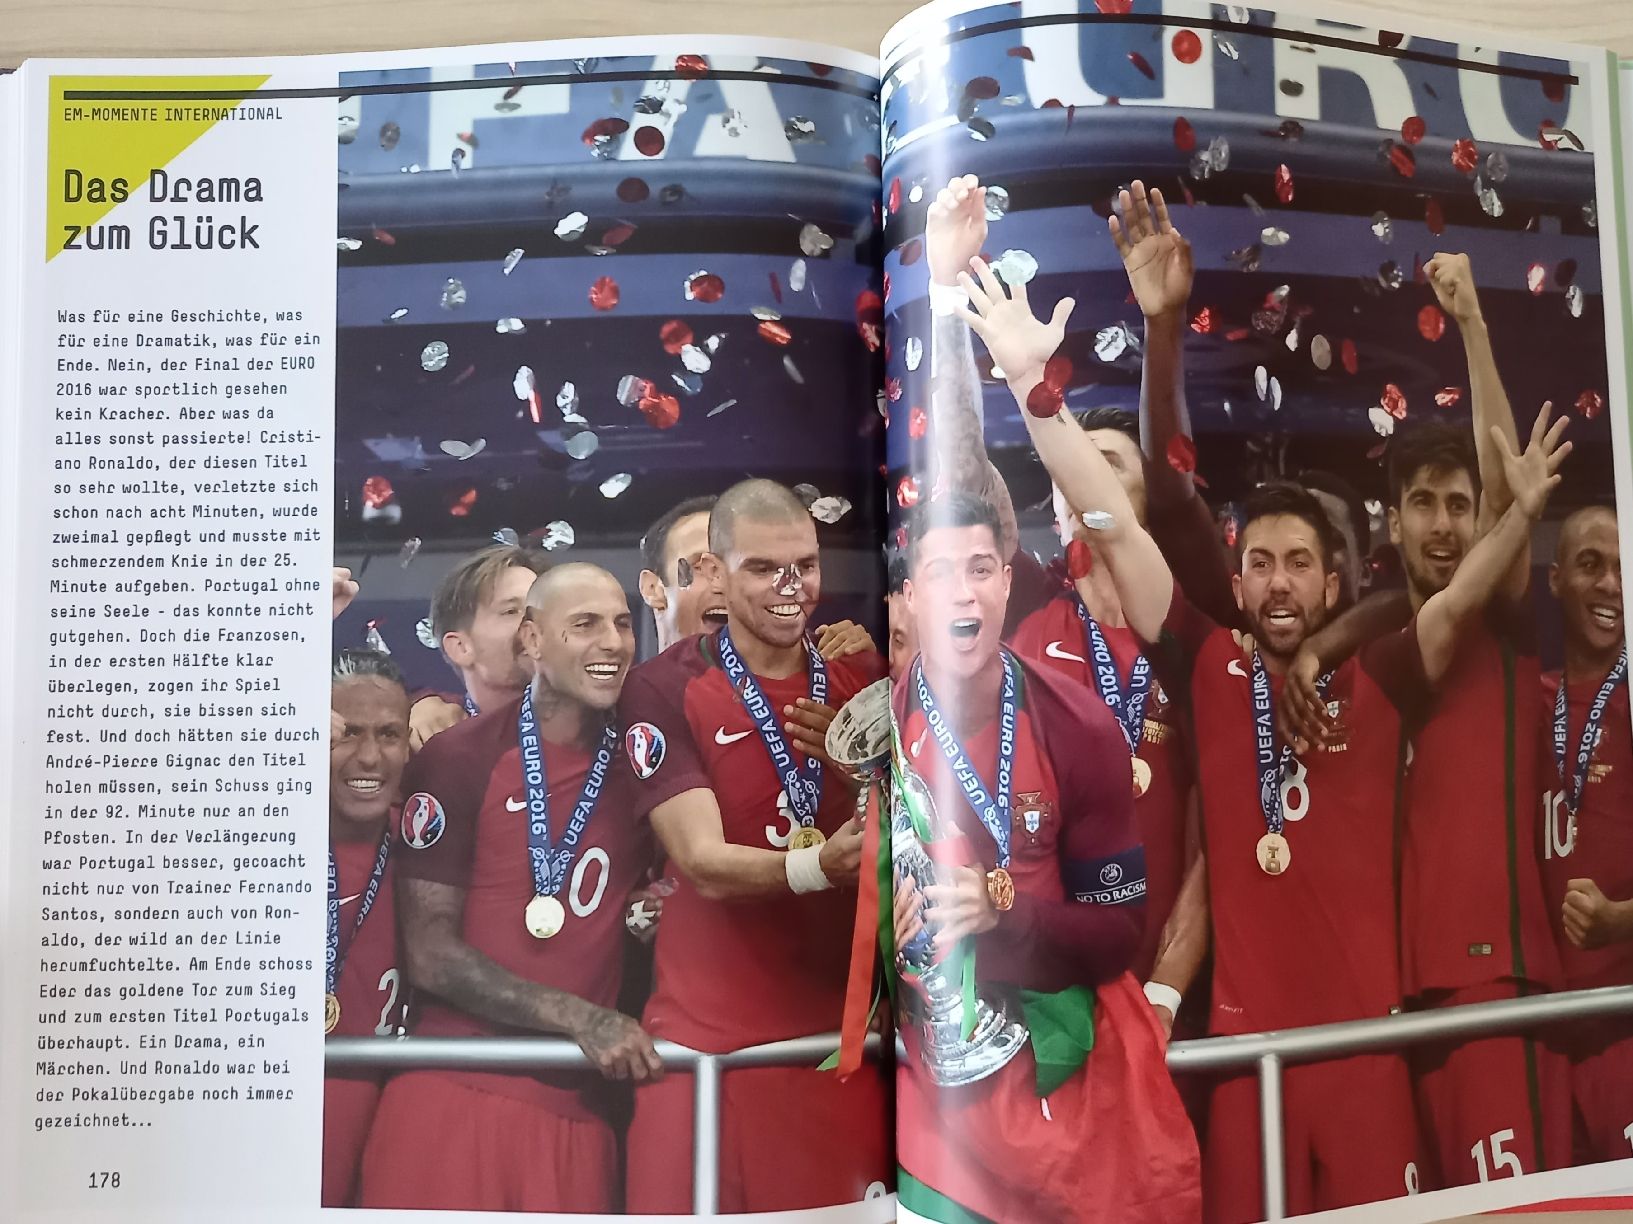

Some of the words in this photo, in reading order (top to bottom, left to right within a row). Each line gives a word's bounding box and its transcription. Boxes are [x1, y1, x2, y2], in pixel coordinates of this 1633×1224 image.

[64, 107, 158, 121] EM-MOMENTE
[164, 106, 283, 122] INTERNATIONAL
[63, 168, 130, 203] Das
[149, 168, 264, 203] Drama
[63, 224, 131, 251] zum
[148, 215, 261, 251] Glück
[57, 309, 86, 324] Was
[92, 309, 121, 323] für
[127, 309, 164, 323] eine
[170, 308, 268, 325] Geschichte,
[275, 311, 303, 322] was
[57, 333, 86, 348] für
[93, 333, 129, 348] eine
[136, 333, 217, 349] Dramatik,
[225, 336, 253, 347] was
[259, 332, 288, 346] für
[294, 331, 321, 346] ein
[57, 358, 100, 372] Ende.
[107, 357, 152, 374] Nein,
[160, 357, 188, 371] der
[195, 357, 241, 371] Final
[246, 356, 274, 371] der
[280, 355, 315, 371] EURO
[55, 407, 92, 421] kein
[99, 406, 170, 421] Kracher.
[178, 406, 216, 420] Aber
[221, 409, 250, 420] was
[256, 405, 274, 420] da
[54, 459, 81, 470] ano
[88, 455, 160, 472] Ronaldo,
[168, 455, 197, 470] der
[203, 455, 257, 469] diesen
[264, 454, 308, 469] Titel
[53, 505, 99, 519] schon
[106, 505, 142, 519] nach
[150, 504, 187, 519] acht
[192, 504, 265, 520] Minuten,
[272, 503, 318, 517] wurde
[52, 529, 120, 544] zweimal
[126, 529, 192, 547] gepflegt
[199, 529, 226, 543] und
[232, 528, 288, 543] musste
[293, 527, 321, 542] mit
[49, 579, 107, 594] Minute
[114, 578, 195, 597] aufgeben.
[204, 577, 279, 596] Portugal
[285, 577, 321, 592] ohne
[49, 628, 131, 647] gutgehen.
[140, 628, 176, 643] Doch
[183, 627, 211, 643] die
[218, 627, 305, 643] Franzosen,
[48, 654, 67, 668] in
[74, 654, 102, 668] der
[109, 653, 166, 668] ersten
[172, 652, 229, 668] Hälfte
[236, 652, 274, 667] klar
[1097, 665, 1121, 707] 2016
[47, 703, 95, 719] nicht
[101, 703, 155, 720] durch,
[164, 703, 191, 718] sie
[198, 702, 253, 717] bissen
[260, 702, 296, 717] sich
[1589, 682, 1615, 721] EURO
[46, 729, 90, 744] fest.
[99, 728, 127, 743] Und
[134, 728, 171, 743] doch
[178, 727, 233, 743] hätten
[240, 727, 267, 742] sie
[274, 727, 320, 742] durch
[928, 709, 960, 758] EURO
[1001, 702, 1015, 757] EURO
[1256, 713, 1274, 764] UEFA
[761, 718, 791, 768] UEFA
[1577, 722, 1596, 764] 2016
[522, 735, 543, 786] EURO
[45, 779, 92, 794] holen
[98, 778, 162, 796] müssen,
[171, 778, 208, 793] sein
[215, 777, 269, 793] Schuss
[276, 777, 312, 796] ging
[952, 755, 987, 806] UEFA
[998, 758, 1012, 809] 2016
[563, 800, 595, 847] UEFA
[584, 749, 611, 800] EURO
[44, 805, 63, 820] in
[70, 804, 98, 819] der
[105, 804, 130, 819] 92.
[138, 803, 196, 819] Minute
[203, 806, 231, 818] nur
[237, 806, 255, 818] an
[262, 802, 289, 817] den
[528, 787, 547, 837] 2016
[765, 789, 802, 848] 3
[1542, 790, 1575, 861] 10
[42, 859, 72, 870] war
[79, 854, 156, 873] Portugal
[162, 854, 224, 871] besser,
[233, 853, 306, 872] gecoacht
[42, 881, 90, 896] nicht
[96, 884, 125, 896] nur
[131, 883, 159, 895] von
[166, 879, 232, 895] Trainer
[239, 879, 312, 894] Fernando
[1076, 895, 1093, 904] NO
[1093, 892, 1112, 904] TO
[41, 932, 85, 949] aldo,
[94, 931, 123, 947] der
[128, 931, 168, 946] wild
[175, 934, 193, 946] an
[200, 930, 228, 945] der
[235, 930, 281, 945] Linie
[40, 956, 180, 973] herumfuchtelte.
[189, 956, 208, 972] Am
[215, 956, 251, 971] Ende
[258, 956, 313, 971] schoss
[38, 1009, 67, 1024] und
[74, 1012, 102, 1024] zum
[109, 1008, 166, 1024] ersten
[173, 1007, 218, 1023] Titel
[225, 1007, 309, 1026] Portugals
[36, 1087, 65, 1103] der
[71, 1085, 195, 1105] Pokalübergabe
[202, 1085, 239, 1101] noch
[245, 1085, 294, 1101] immer
[34, 1112, 152, 1132] gezeichnet...
[1470, 1128, 1504, 1184] 15
[88, 1171, 121, 1189] 178
